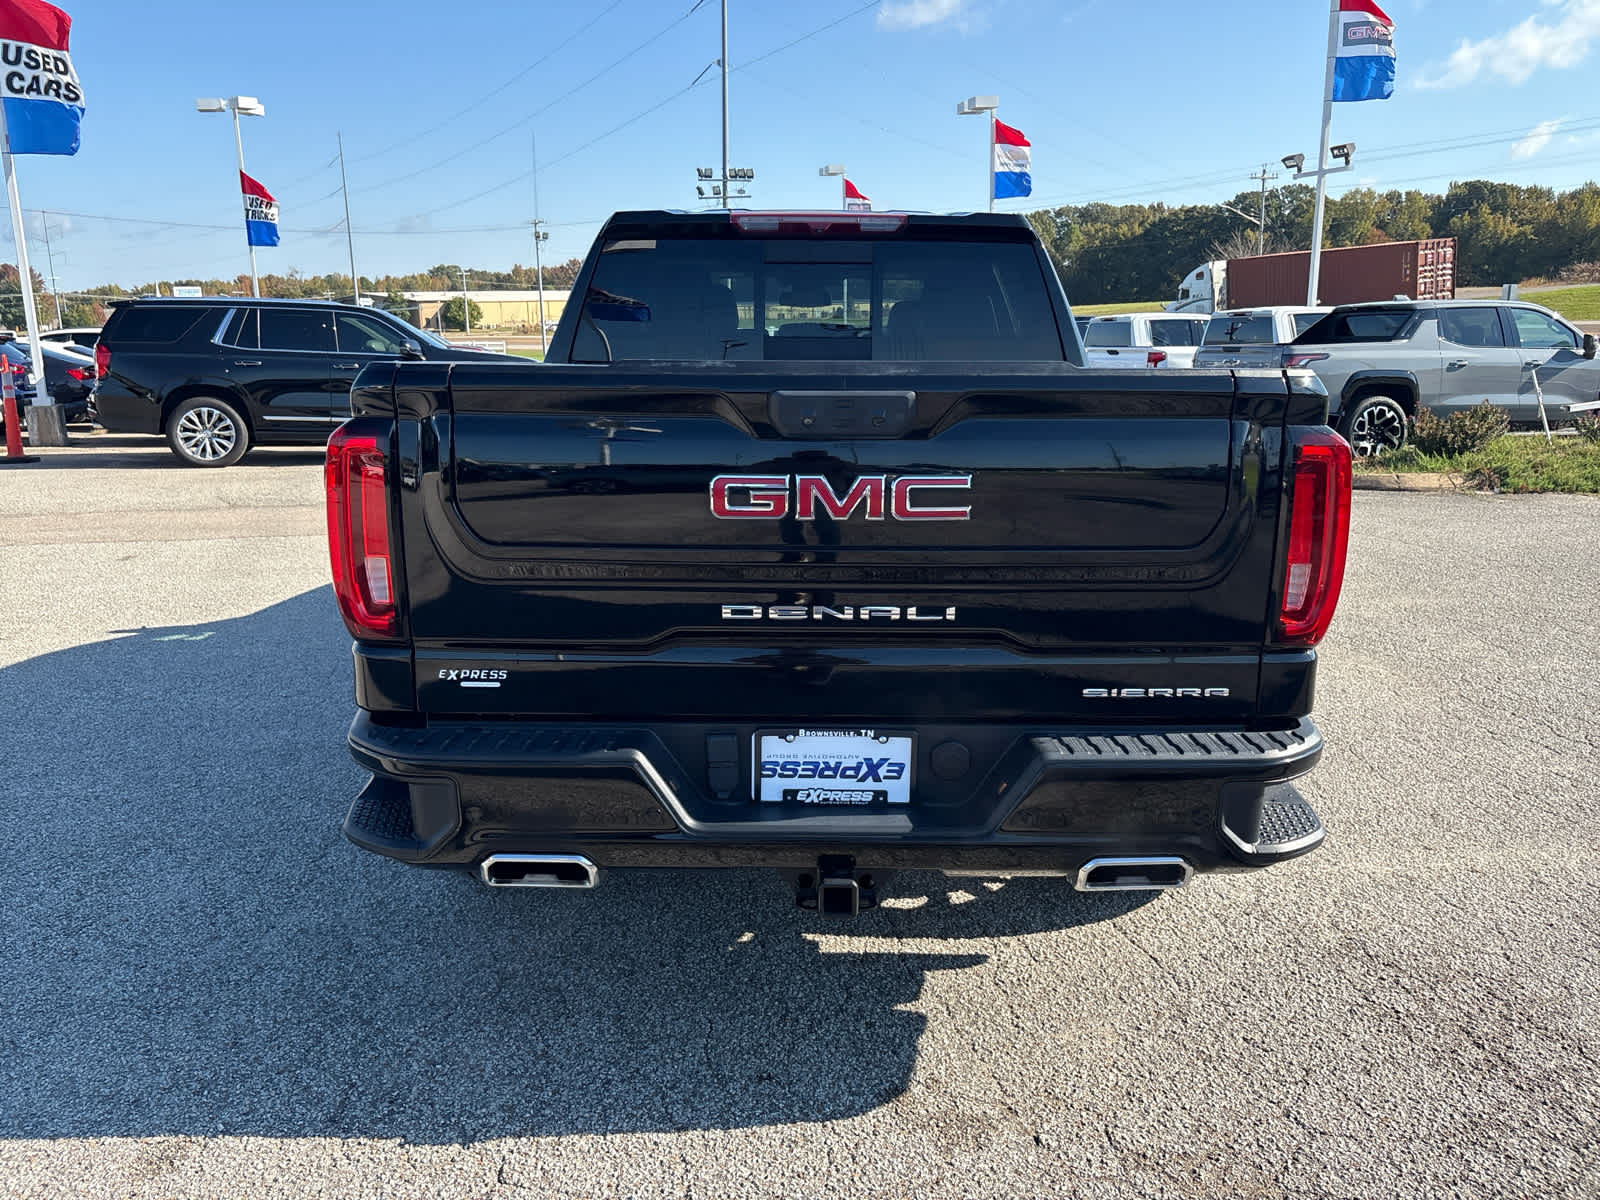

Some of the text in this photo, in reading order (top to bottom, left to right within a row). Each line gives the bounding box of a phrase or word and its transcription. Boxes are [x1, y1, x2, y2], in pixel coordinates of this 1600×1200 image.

[1, 42, 69, 76] USED
[5, 71, 81, 102] CARS
[248, 196, 273, 210] USED
[245, 208, 276, 221] TRUCKS
[709, 474, 972, 521] GMC
[721, 604, 956, 621] DENALI
[438, 669, 508, 681] EXPRESS
[1082, 688, 1230, 698] SIERRA
[860, 729, 875, 738] TN
[761, 757, 905, 783] EXPRESS
[797, 788, 874, 804] EXPRESS
